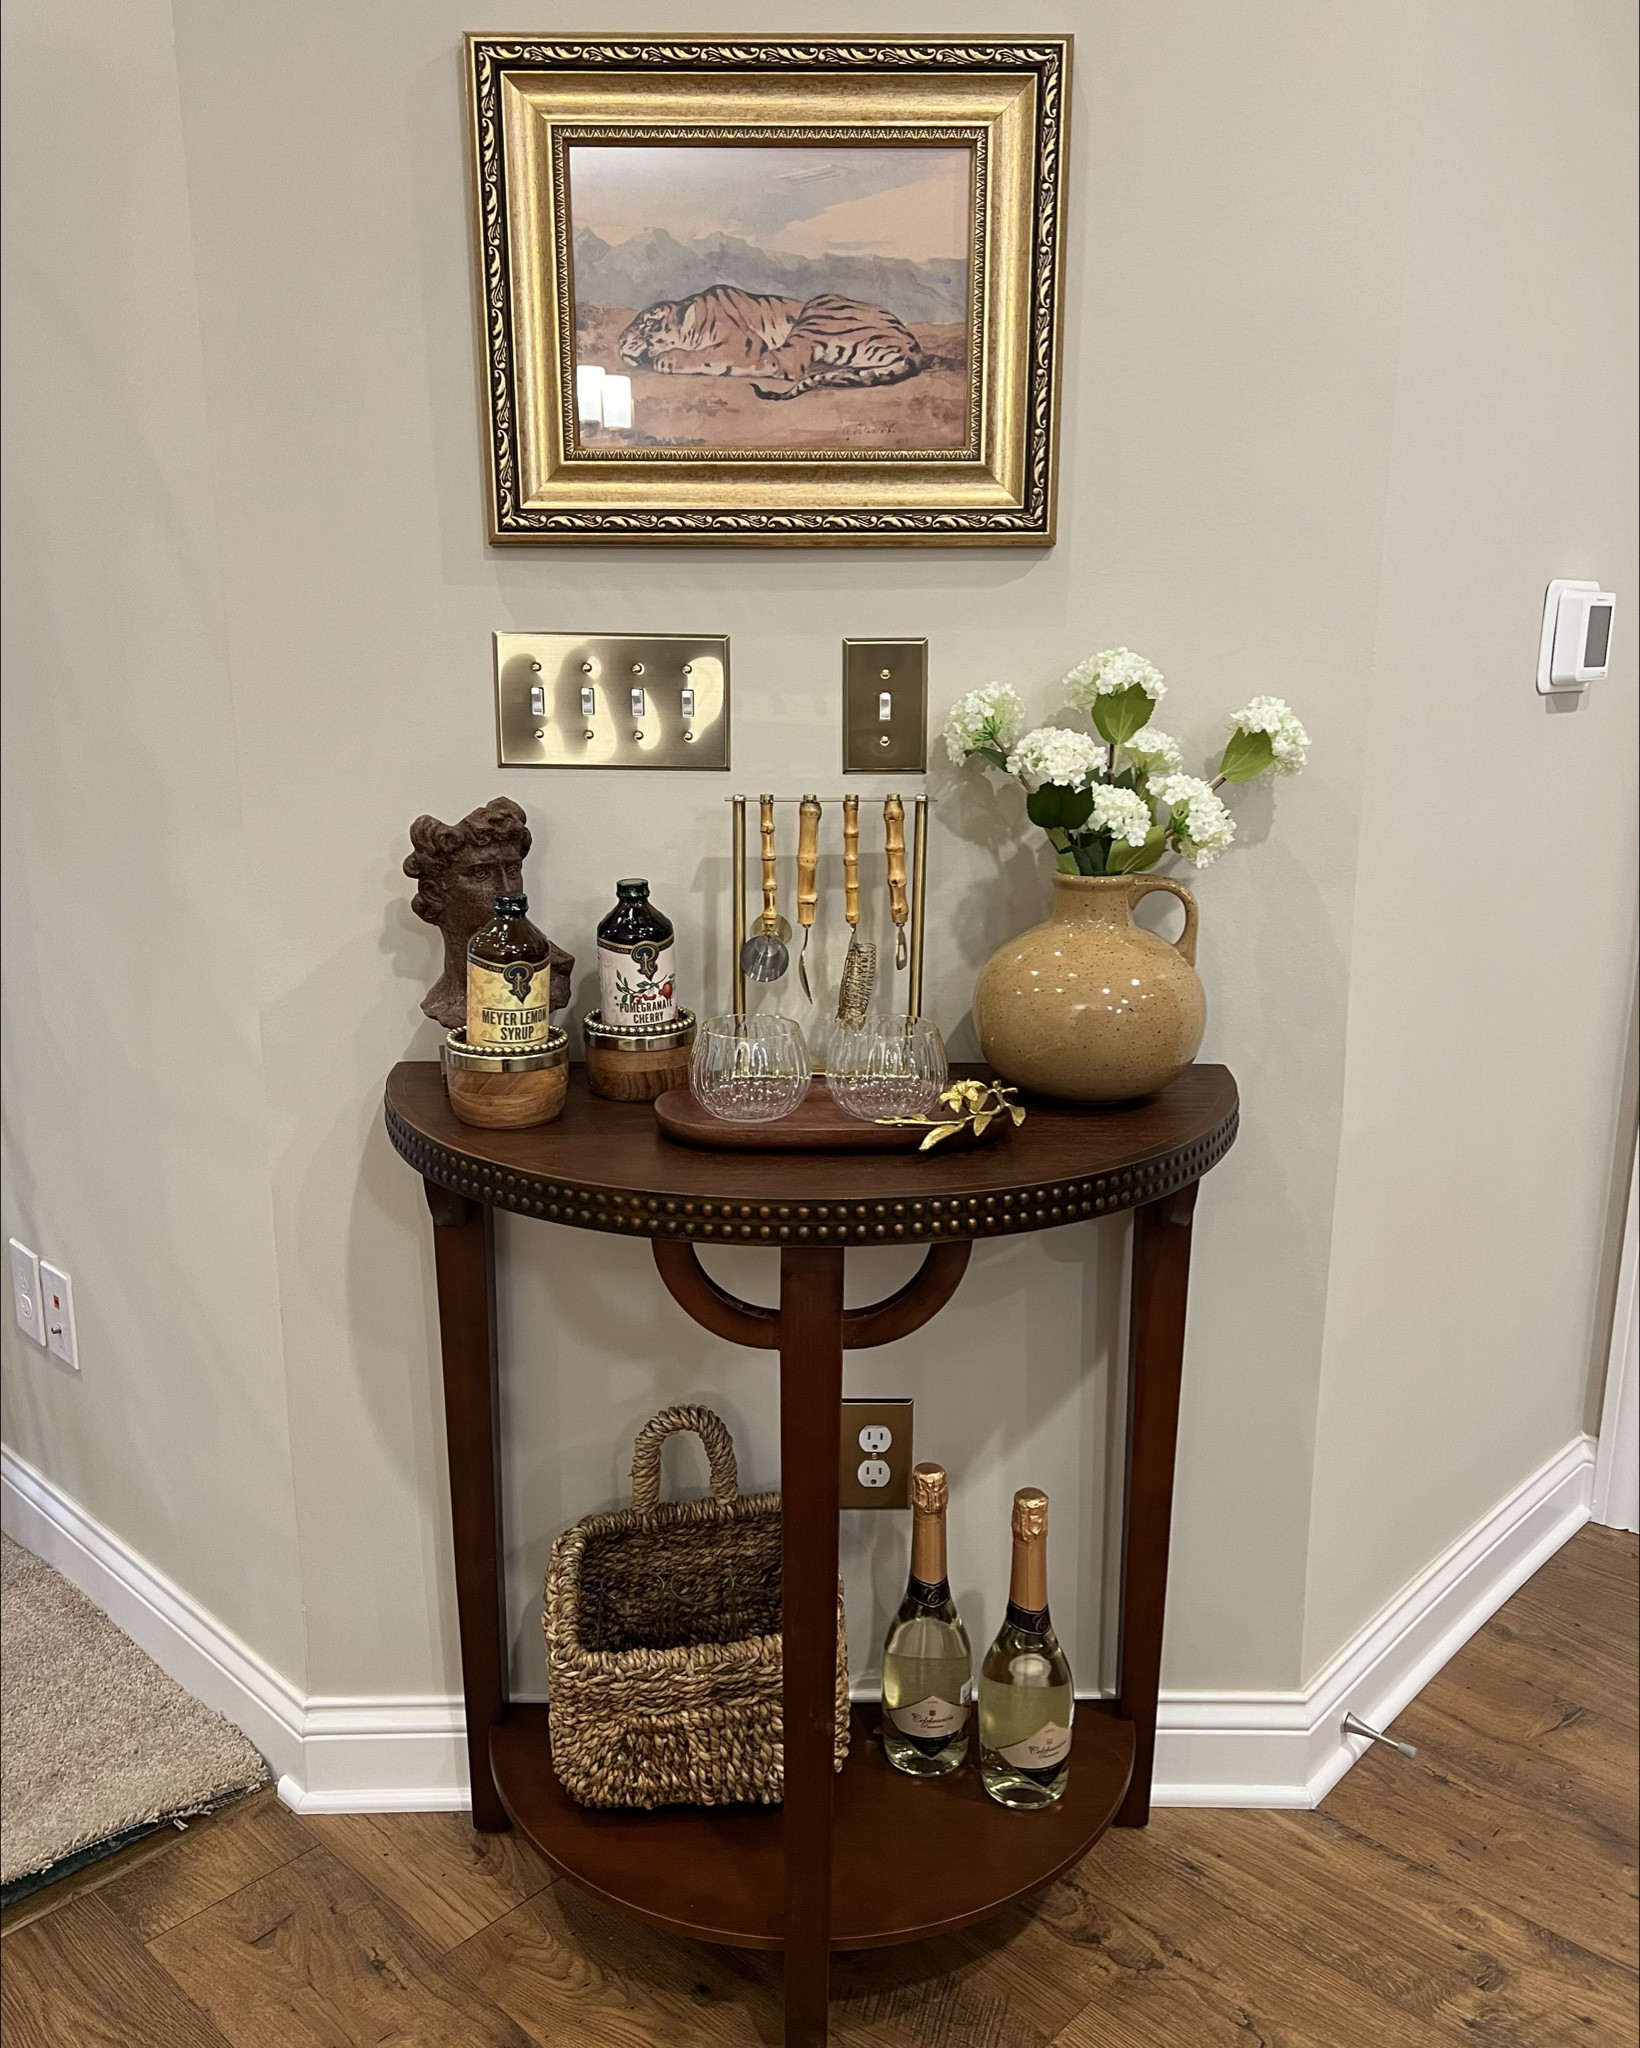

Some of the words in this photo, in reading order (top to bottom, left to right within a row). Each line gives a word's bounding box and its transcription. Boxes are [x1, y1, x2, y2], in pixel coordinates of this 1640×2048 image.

[482, 1009, 517, 1026] MEYER
[520, 1006, 547, 1026] LEMON
[633, 1011, 664, 1024] CHERRY
[500, 1026, 535, 1041] SYRUP
